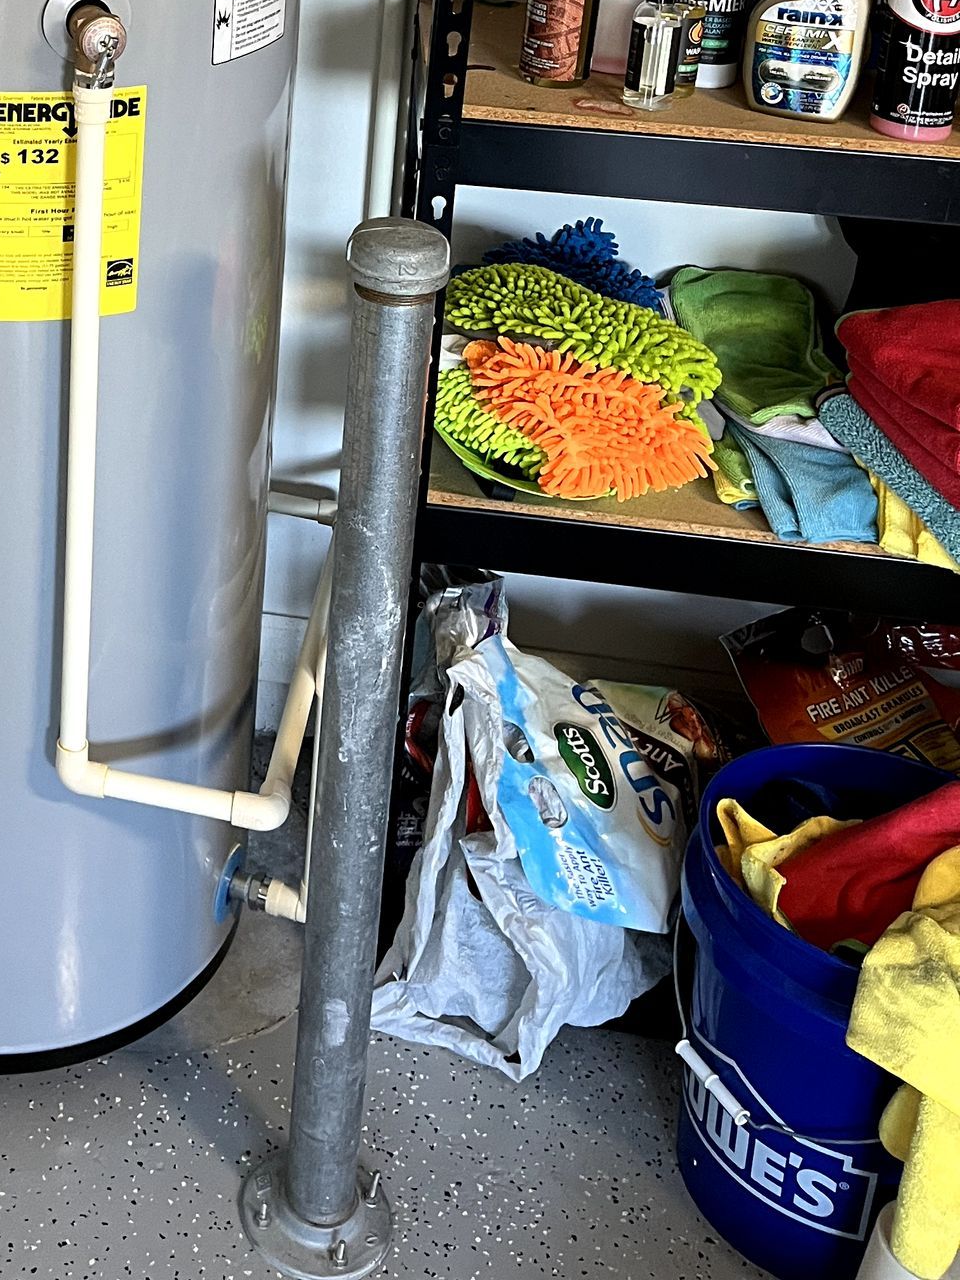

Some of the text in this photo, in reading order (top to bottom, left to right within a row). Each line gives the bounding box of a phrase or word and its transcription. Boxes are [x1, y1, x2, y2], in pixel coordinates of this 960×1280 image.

[902, 66, 959, 90] Spray
[17, 148, 59, 164] 132
[806, 697, 841, 723] FIRE
[842, 686, 871, 711] ANT
[832, 686, 924, 735] BROADCAST GRANULES
[562, 726, 610, 797] Scotts
[576, 850, 605, 901] Fire Ant
[590, 858, 615, 896] Killer!
